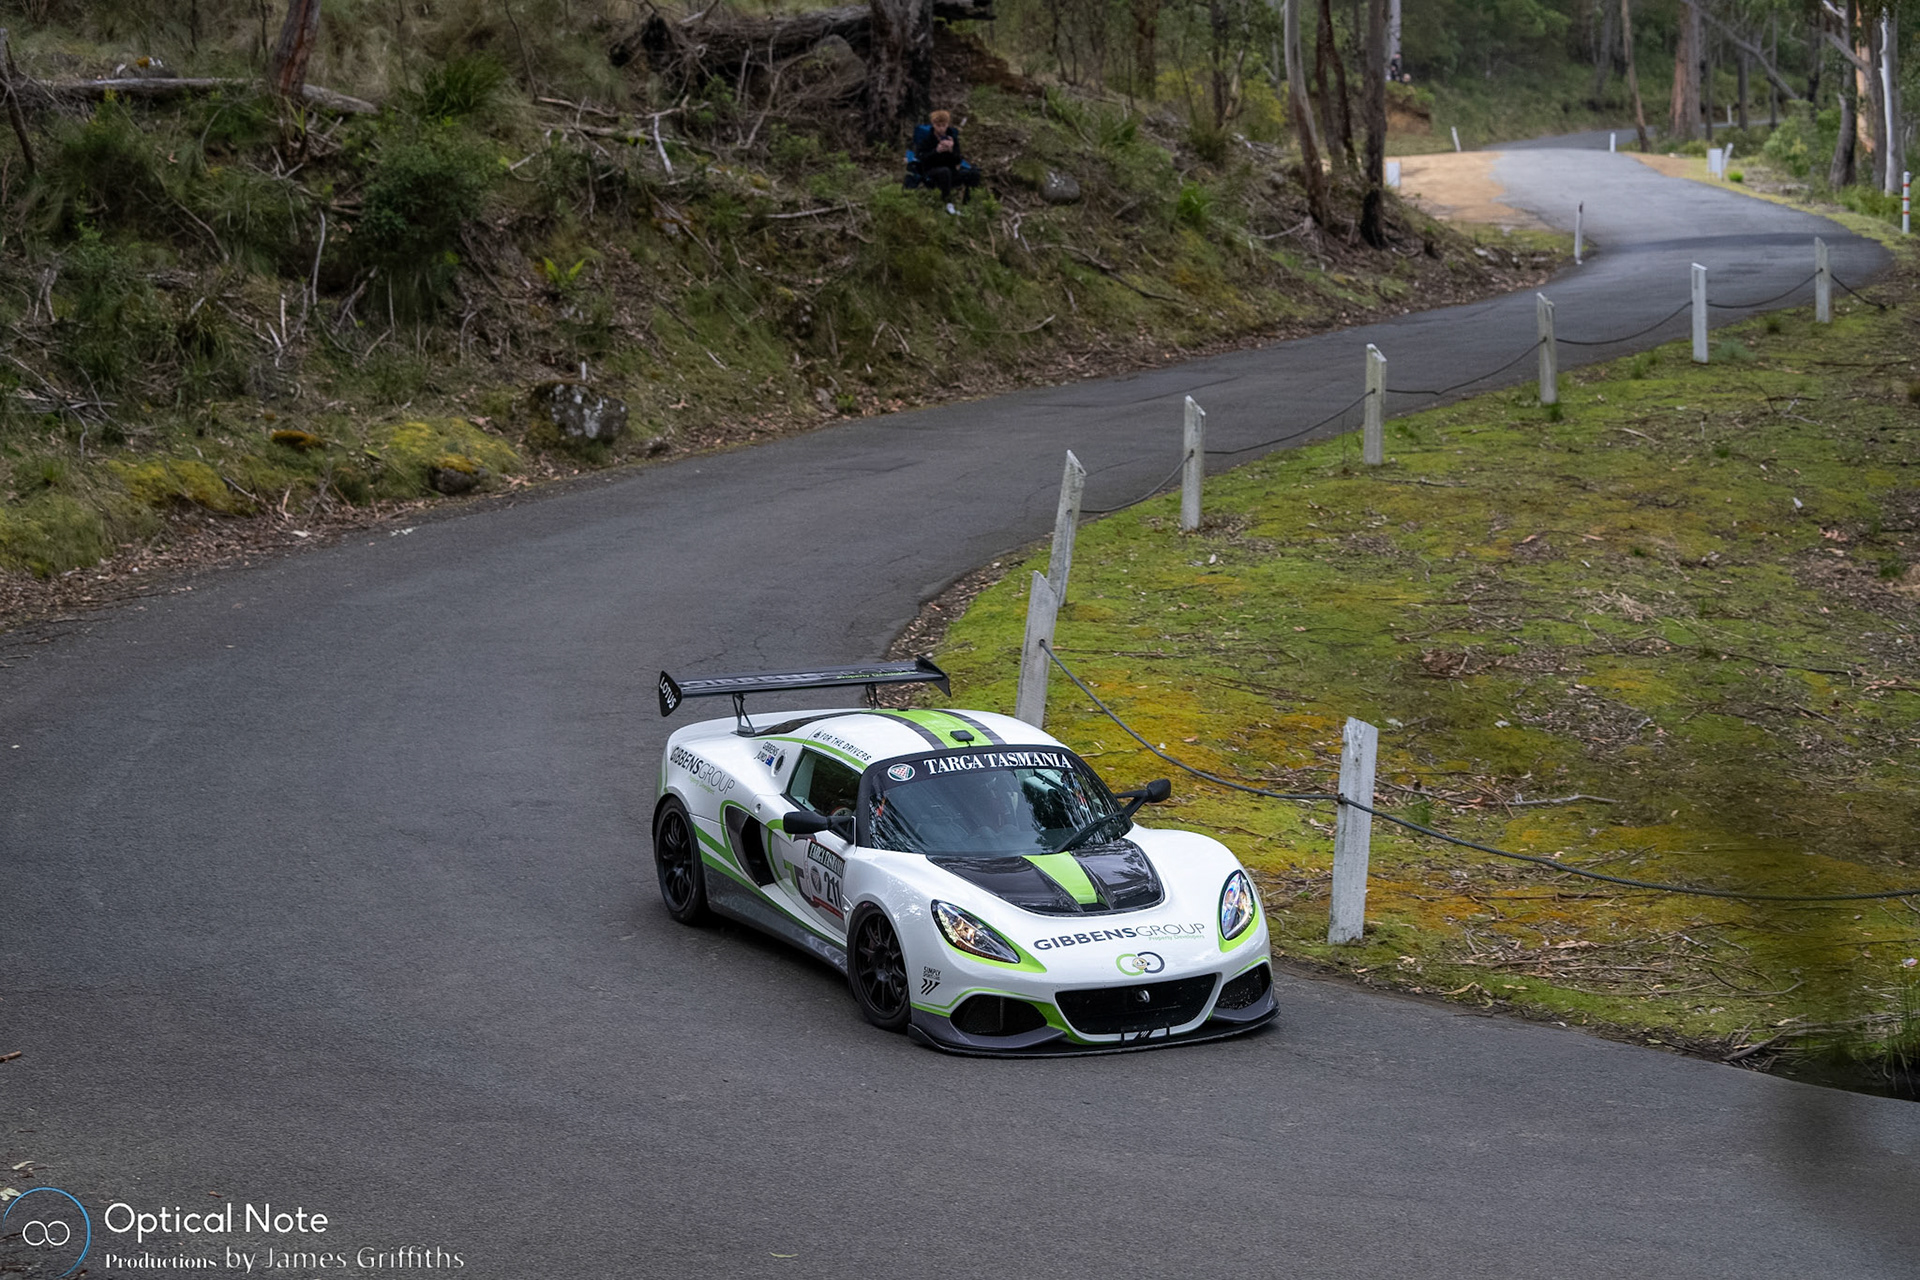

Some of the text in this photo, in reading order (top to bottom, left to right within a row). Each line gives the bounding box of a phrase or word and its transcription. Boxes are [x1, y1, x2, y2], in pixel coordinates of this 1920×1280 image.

[660, 676, 677, 709] LOTUS
[762, 741, 779, 757] GIBBENS
[820, 732, 872, 761] FOR THE DRIVERS
[924, 752, 1073, 775] TARGA TASMANIA
[809, 843, 826, 864] TARGA
[823, 871, 843, 911] 211
